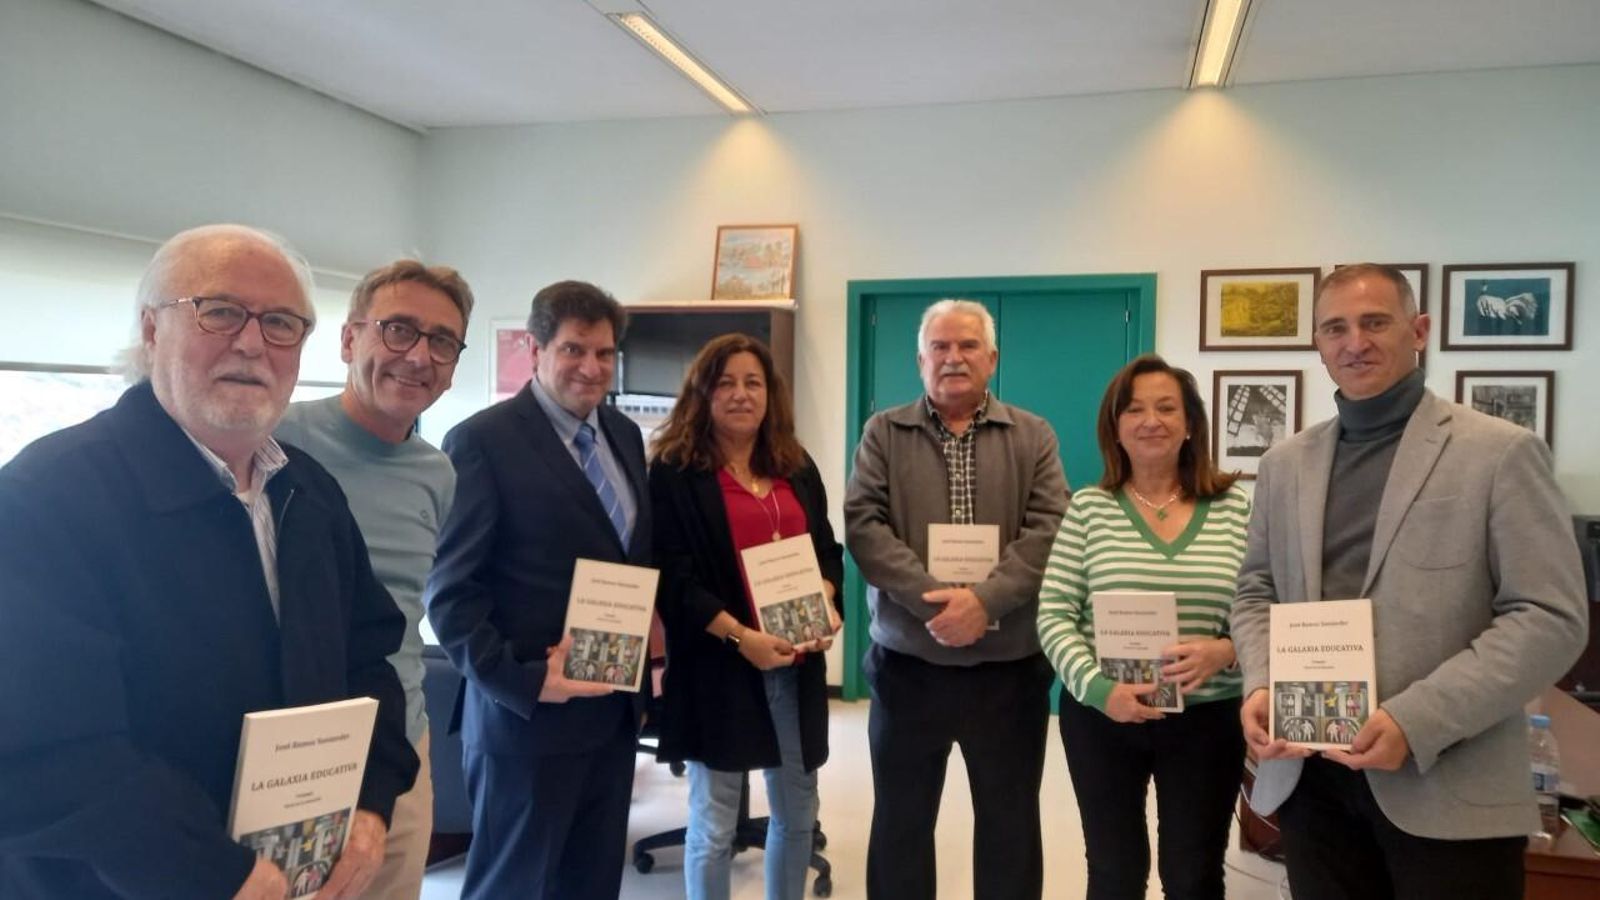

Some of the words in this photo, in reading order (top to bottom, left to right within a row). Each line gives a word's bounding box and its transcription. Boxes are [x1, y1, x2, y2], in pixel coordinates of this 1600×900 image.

[1288, 644, 1320, 653] GALAXIA
[1320, 644, 1364, 652] EDUCATIVA
[251, 781, 264, 792] LA
[266, 772, 308, 790] GALAXIA
[310, 762, 358, 781] EDUCATIVA
